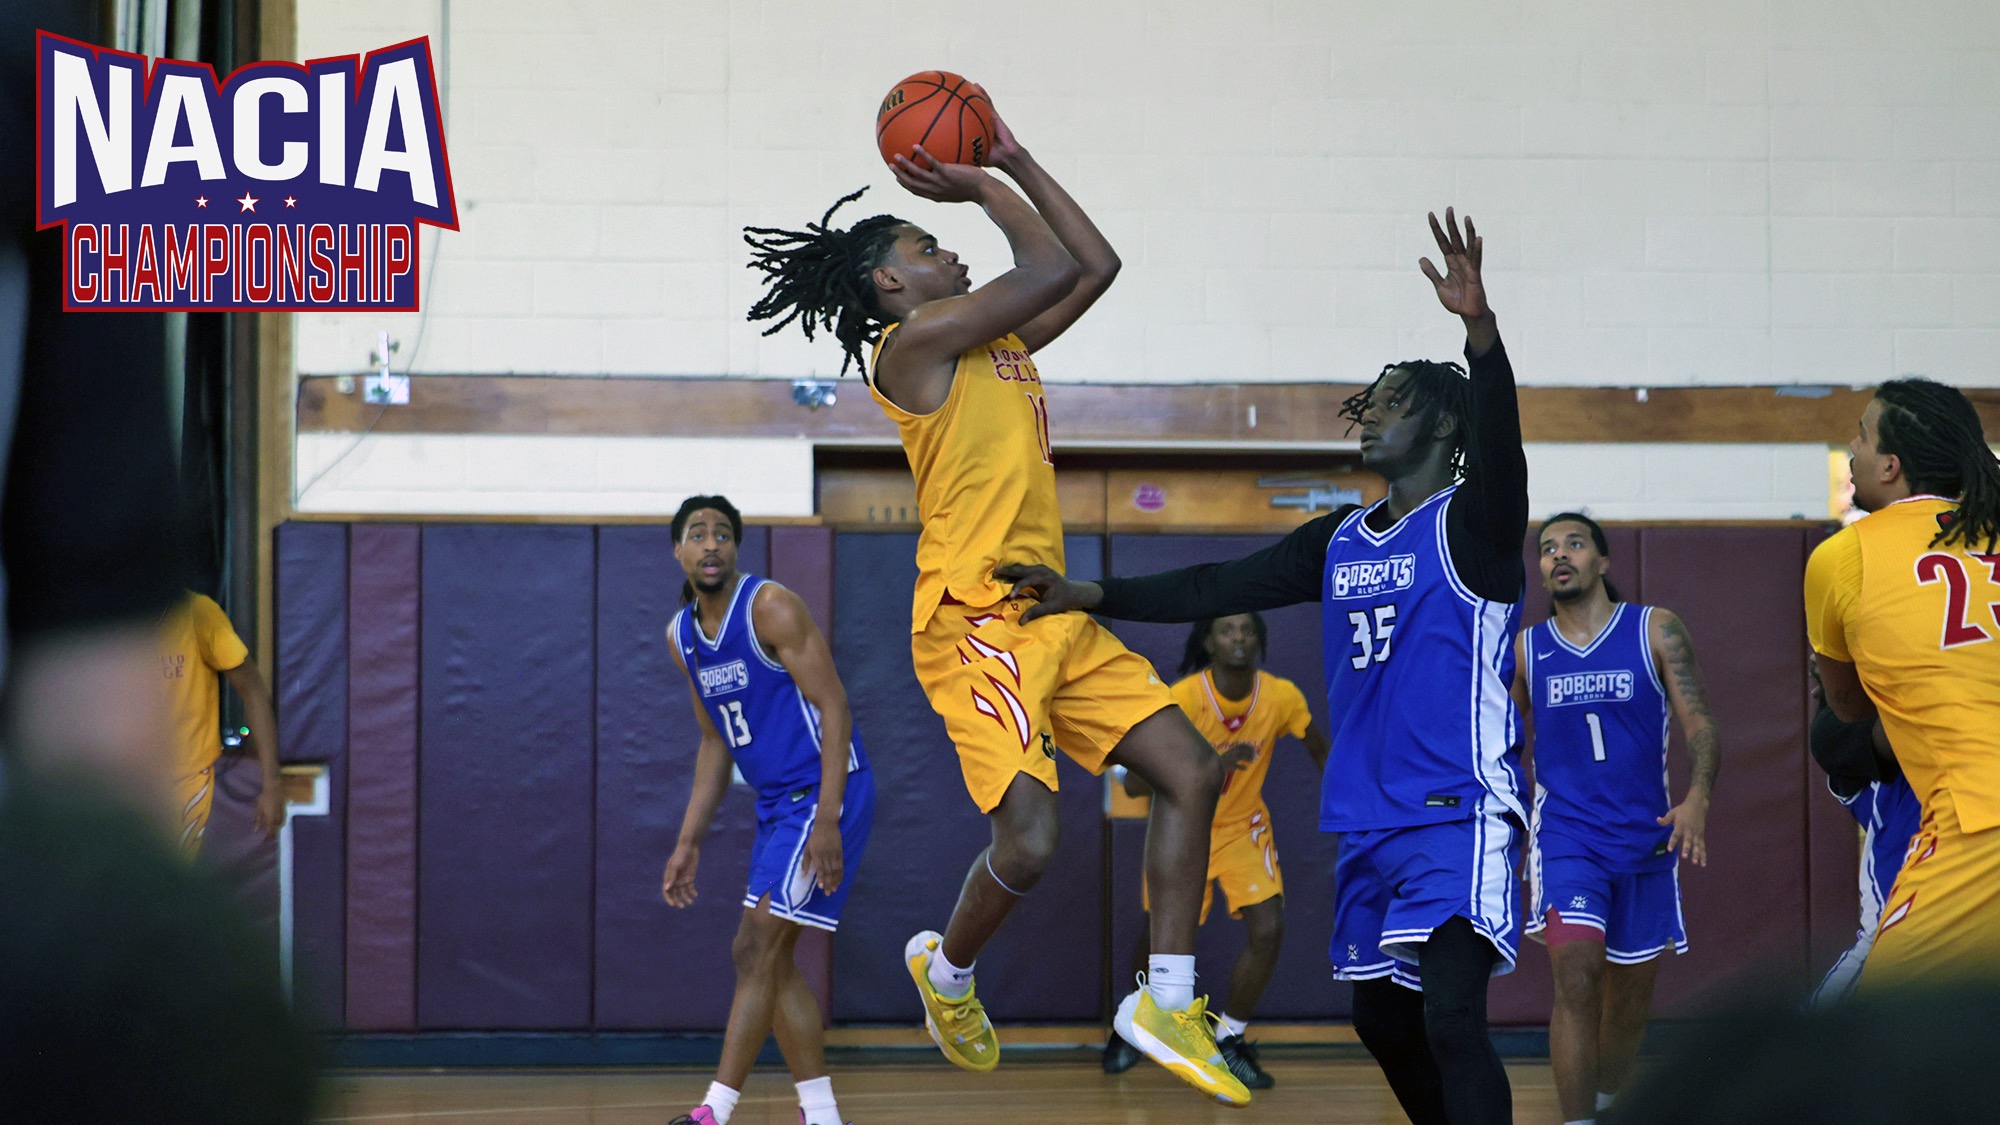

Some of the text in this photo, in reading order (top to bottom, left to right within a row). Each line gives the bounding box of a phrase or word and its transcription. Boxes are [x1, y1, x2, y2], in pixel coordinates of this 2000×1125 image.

[1335, 557, 1413, 597] BOBCATS
[1347, 604, 1397, 671] 35
[699, 662, 748, 694] BOBCATS
[1550, 672, 1631, 704] BOBCATS
[718, 700, 753, 749] 13
[1585, 712, 1607, 762] 1
